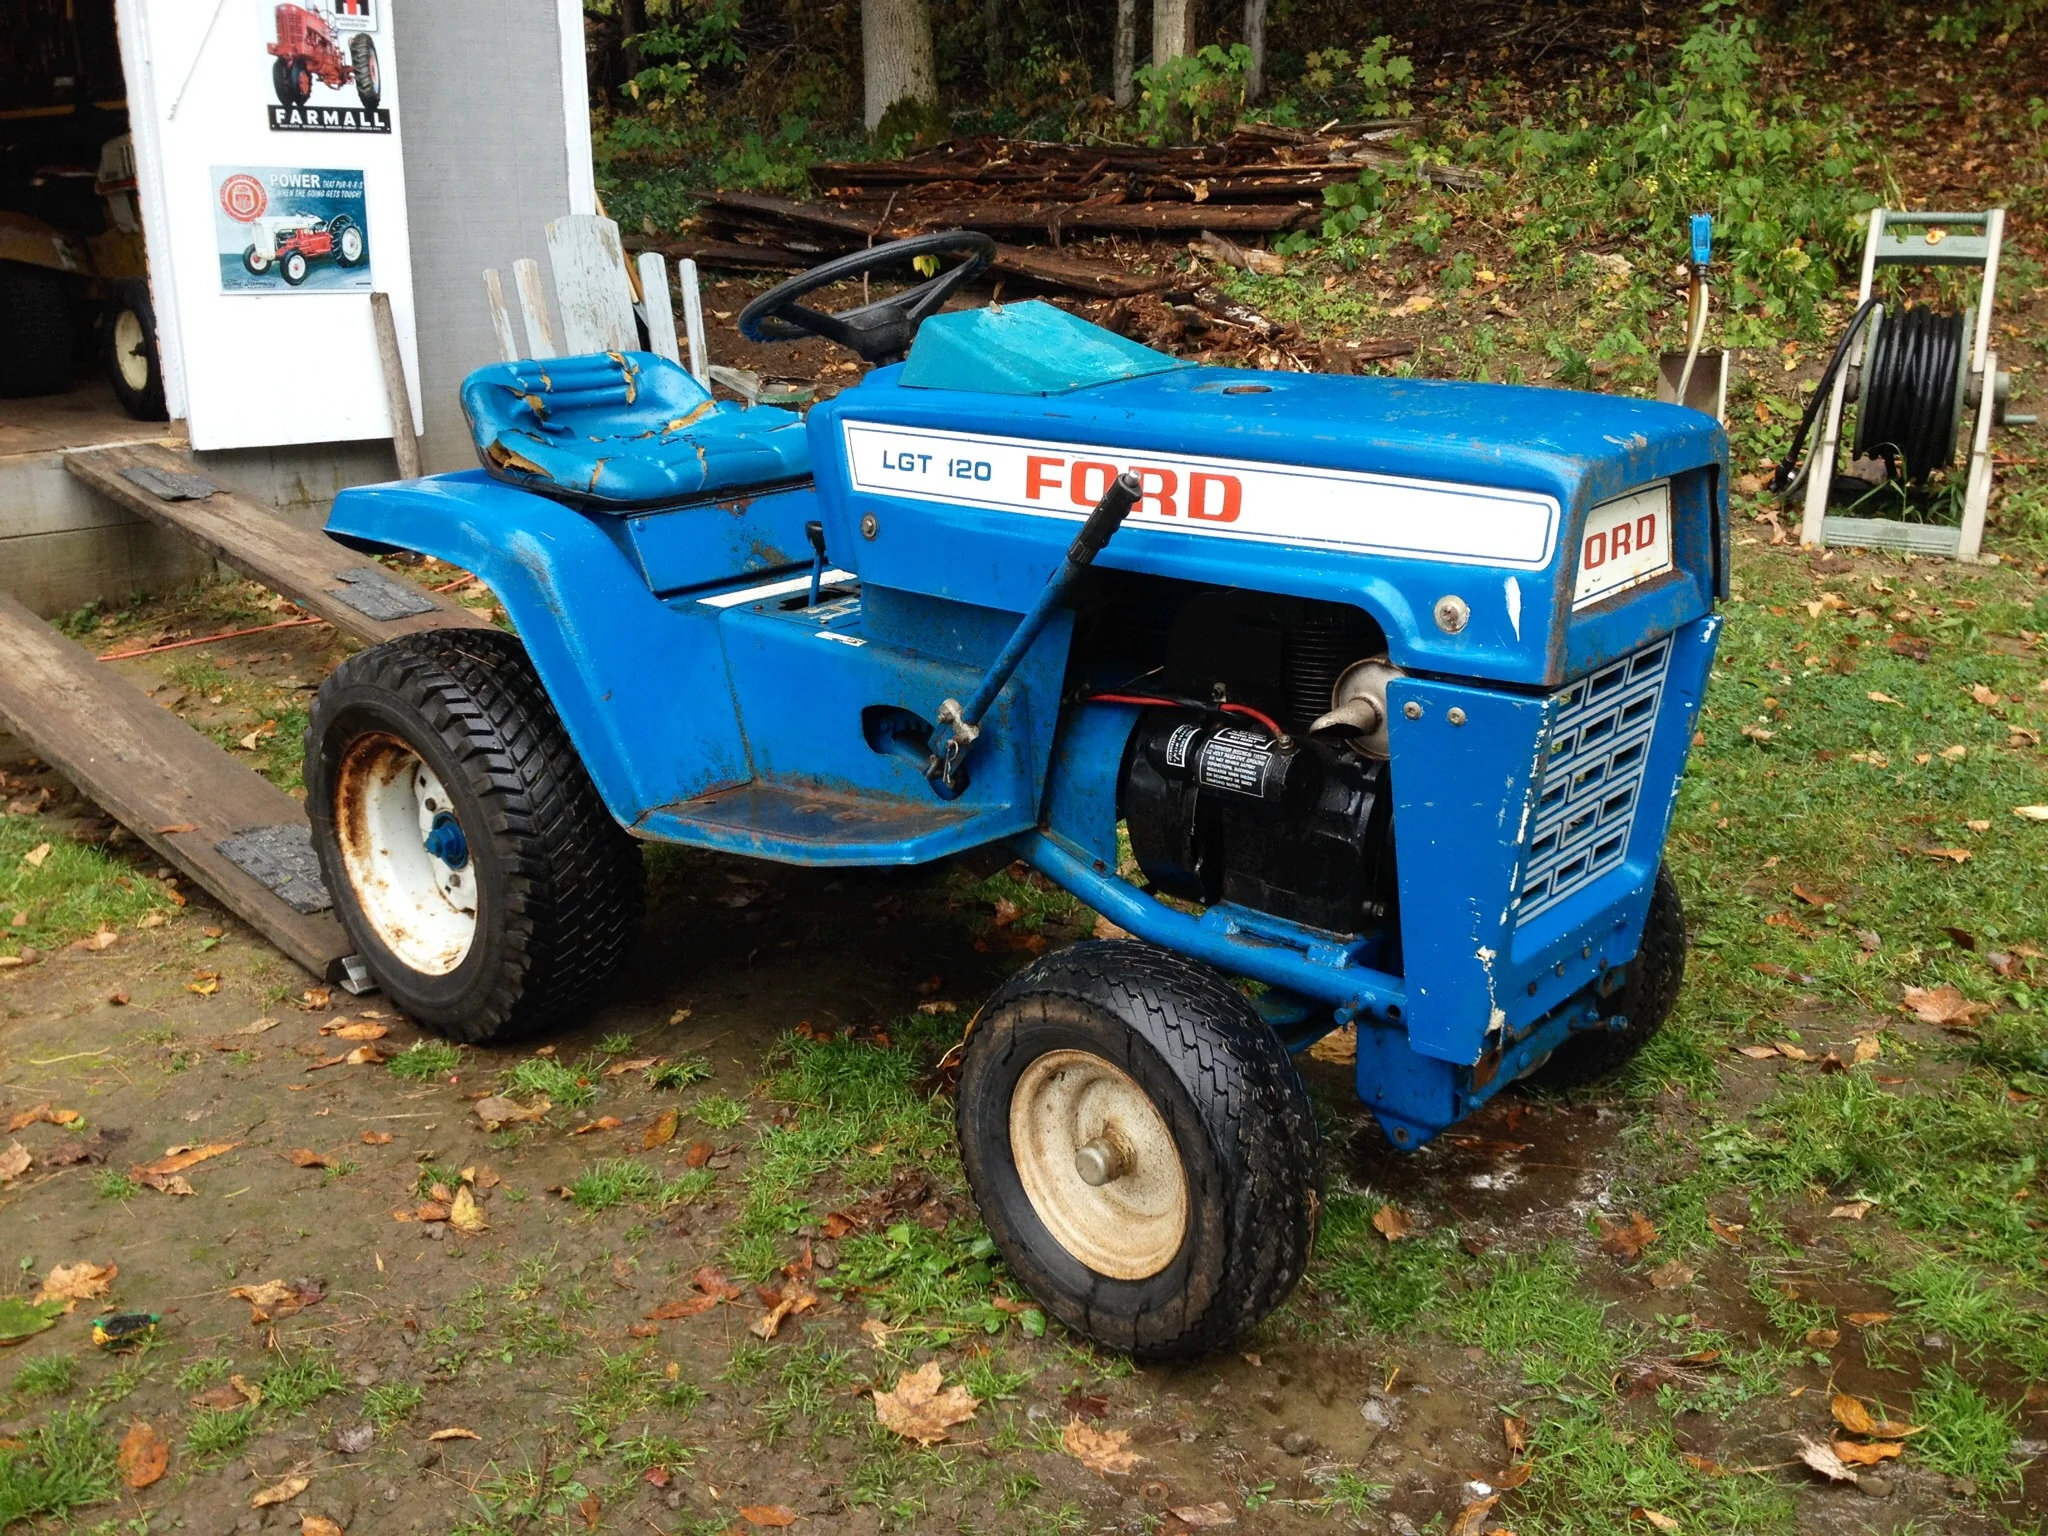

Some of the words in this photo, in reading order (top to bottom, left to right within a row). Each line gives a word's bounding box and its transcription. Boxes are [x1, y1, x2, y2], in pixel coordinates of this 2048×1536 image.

[275, 108, 386, 127] FARMALL
[270, 174, 321, 188] POWER
[323, 180, 335, 188] THAT
[335, 180, 363, 189] PUR-R-R-S
[295, 189, 306, 197] THE
[307, 190, 326, 198] GOING
[326, 190, 340, 198] GETS
[341, 190, 363, 199] TOUGH!
[883, 450, 933, 474] LGT
[947, 457, 992, 483] 120
[1025, 455, 1243, 523] FORD
